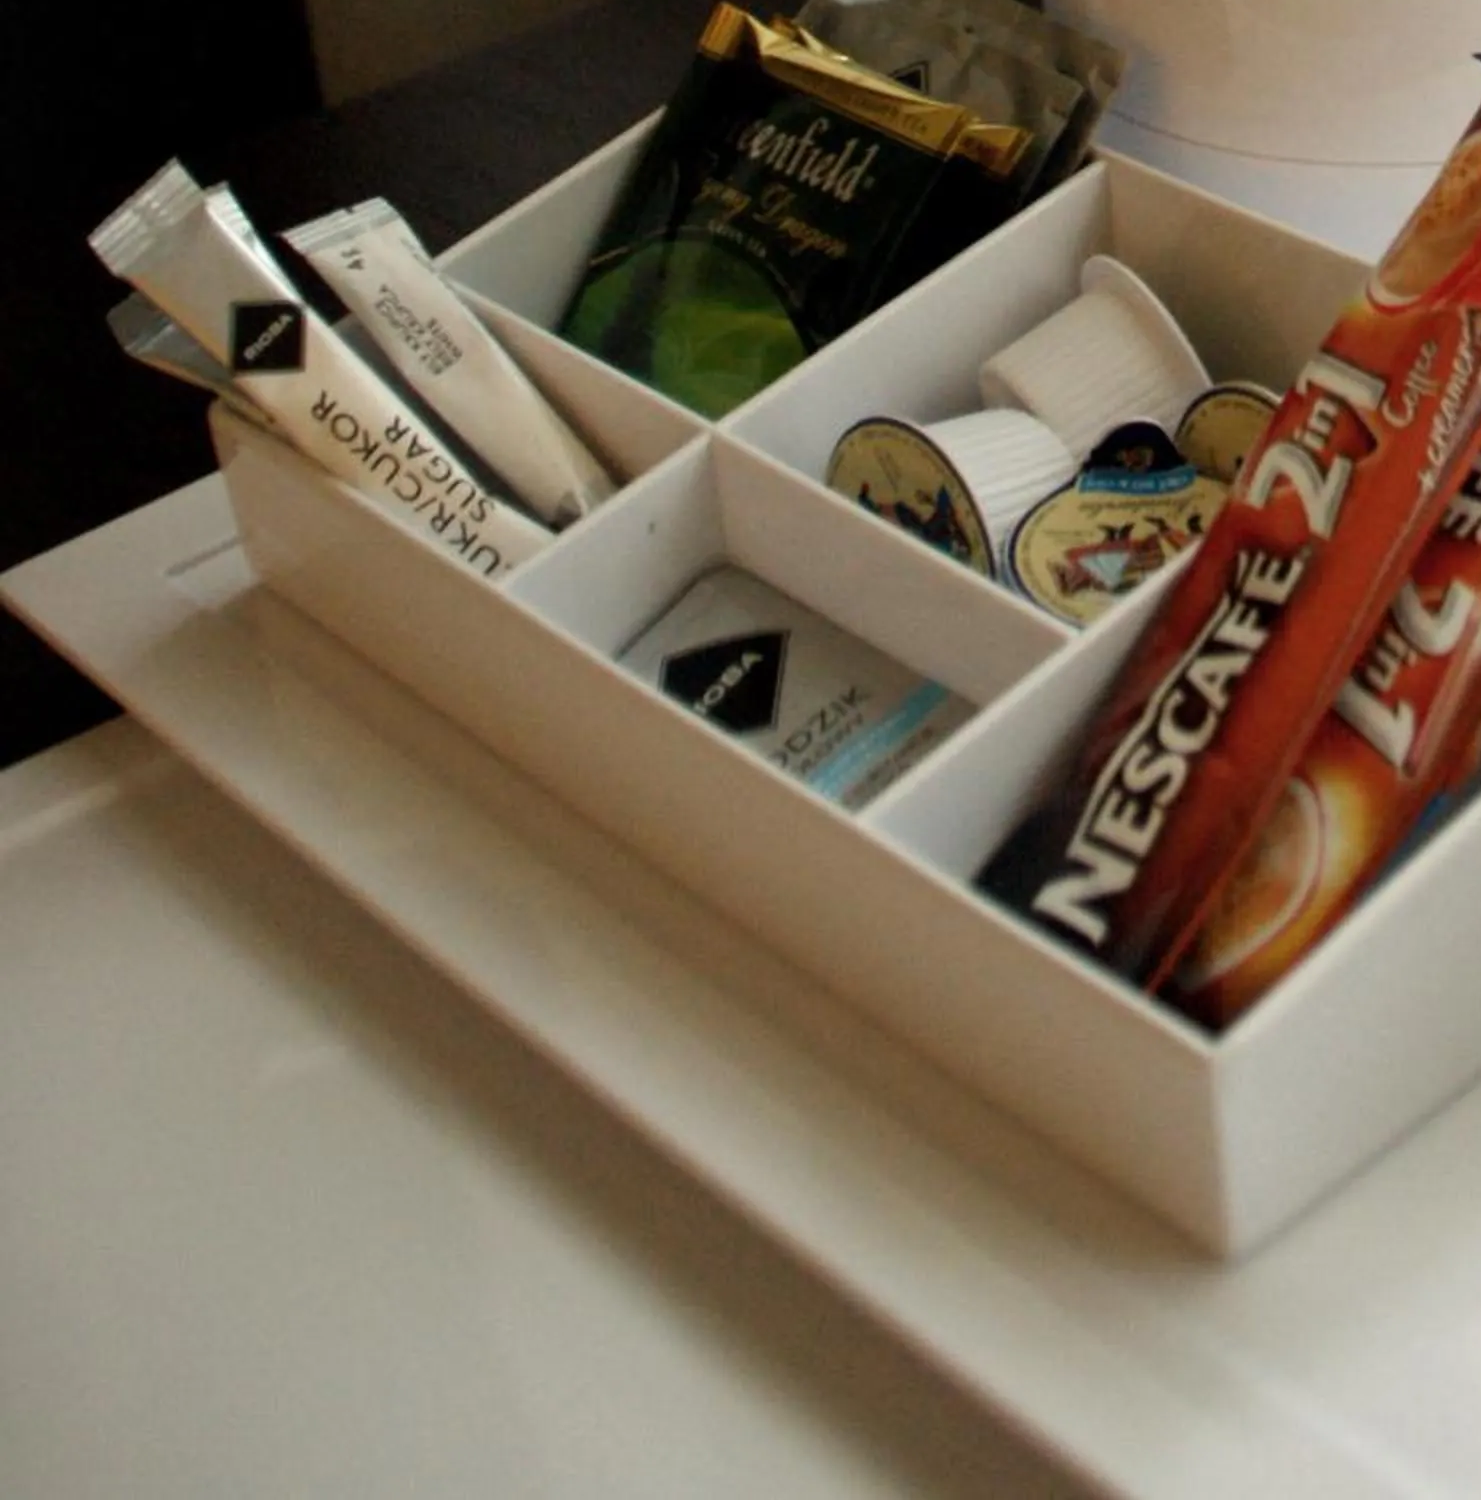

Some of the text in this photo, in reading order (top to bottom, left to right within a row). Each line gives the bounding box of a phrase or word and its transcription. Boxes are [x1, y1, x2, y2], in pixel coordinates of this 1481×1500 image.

[728, 116, 882, 204] eenfield
[242, 312, 295, 364] RIOBA
[1381, 339, 1439, 430] Coffee
[309, 389, 515, 576] UKR/CUKOR
[384, 414, 497, 525] SUGAR
[692, 650, 765, 716] IOBA
[1030, 547, 1303, 943] NESCAFÉ
